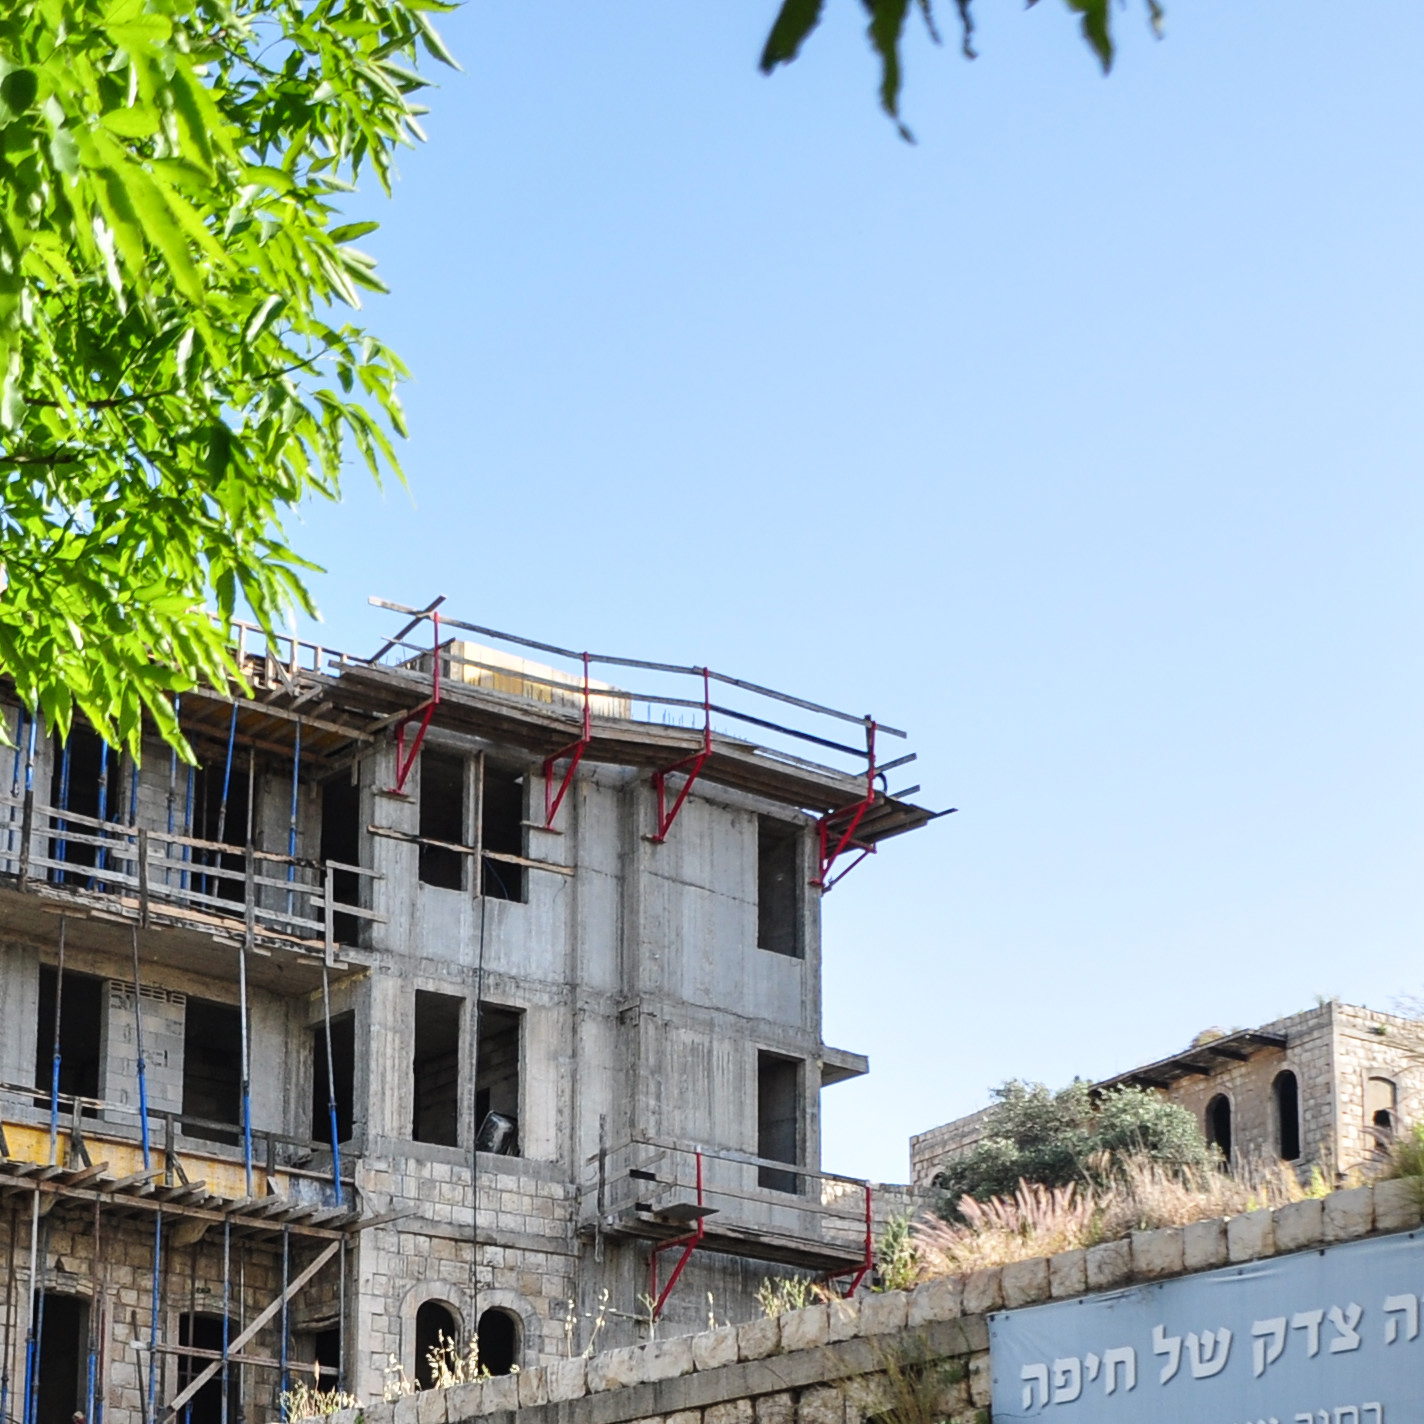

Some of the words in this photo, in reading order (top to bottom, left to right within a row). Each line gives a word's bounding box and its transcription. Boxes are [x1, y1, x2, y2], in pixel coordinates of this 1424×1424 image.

[1152, 1323, 1233, 1386] של
[1251, 1302, 1364, 1379] צדק
[1020, 1344, 1137, 1411] חיפה
